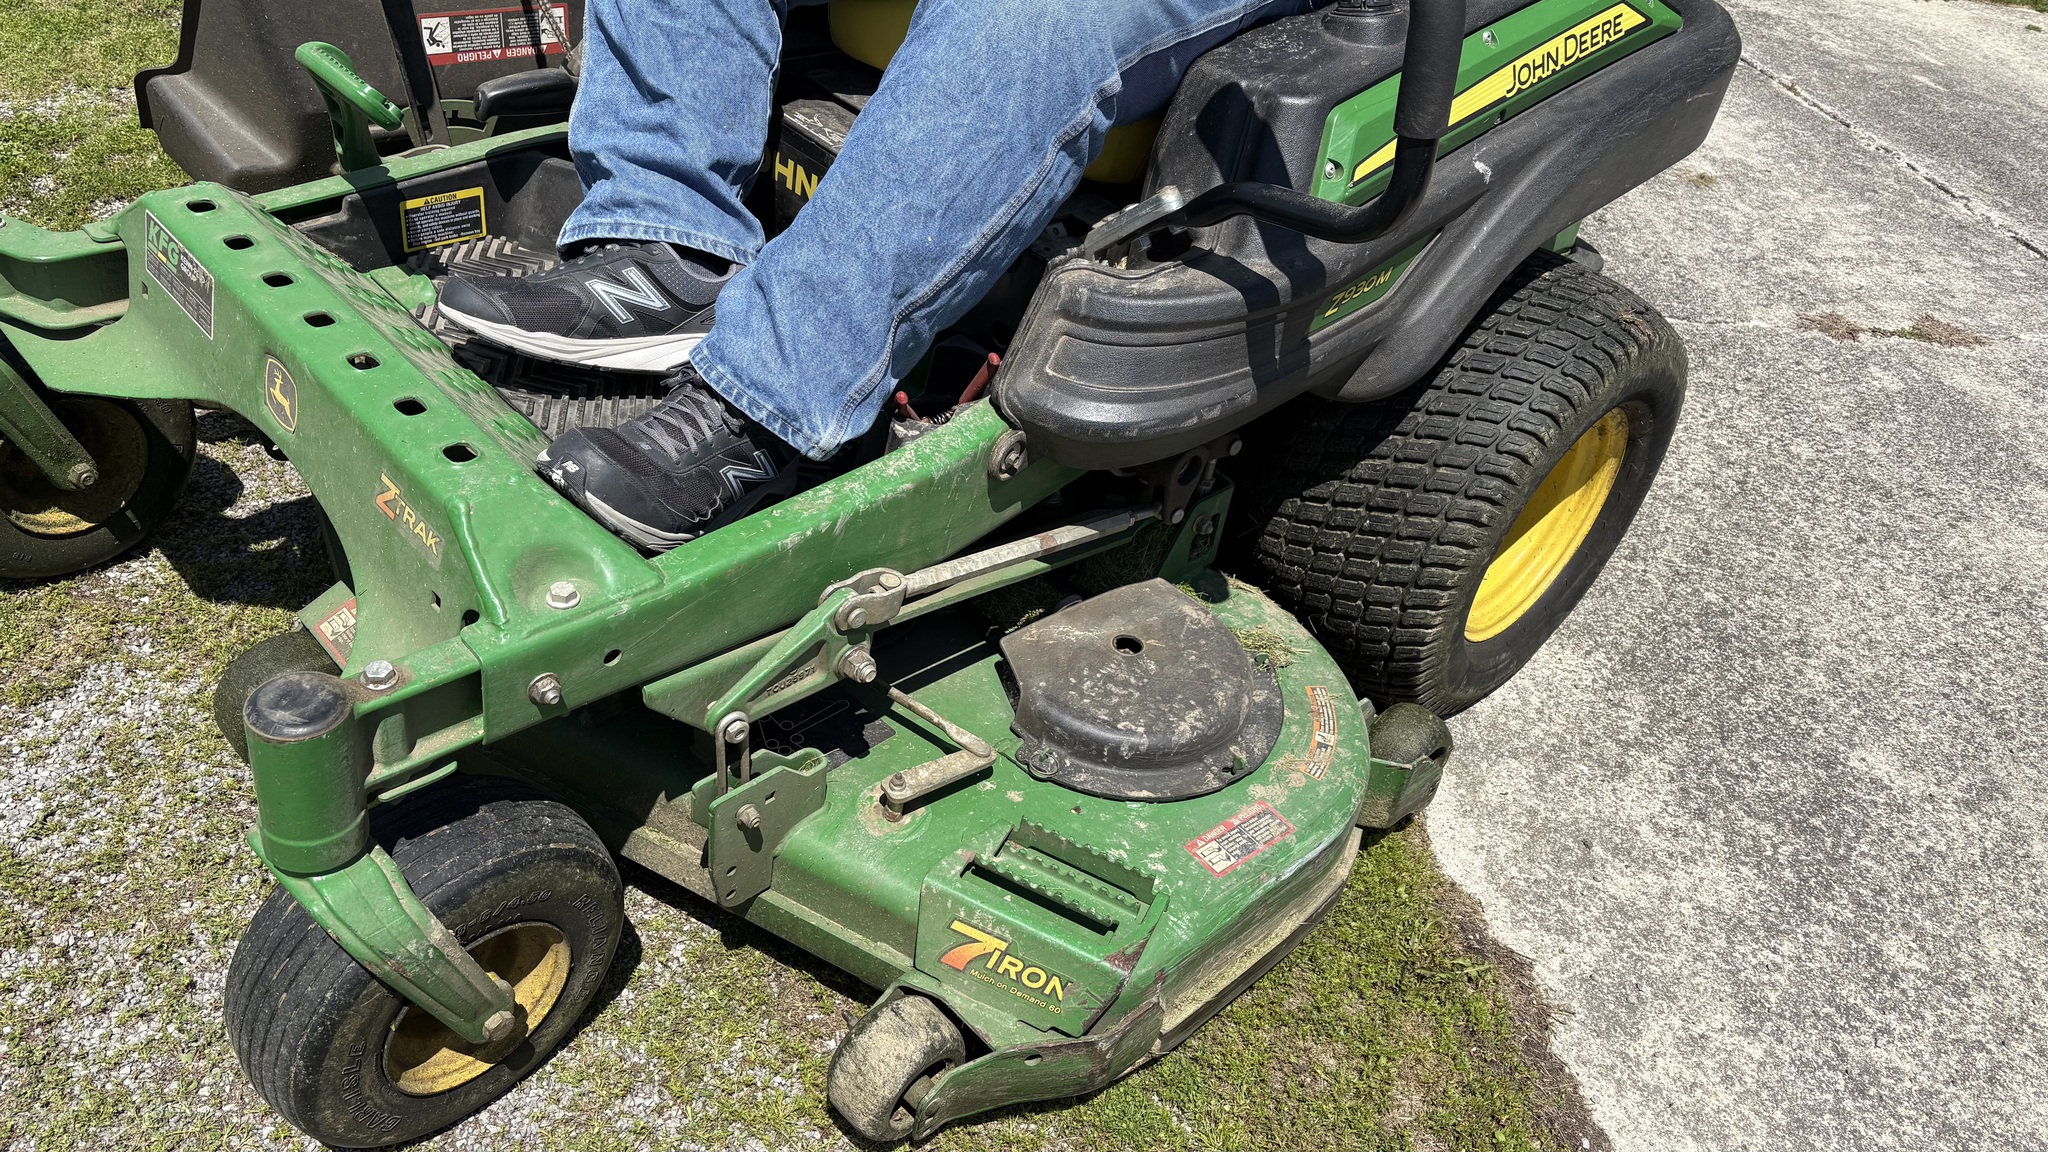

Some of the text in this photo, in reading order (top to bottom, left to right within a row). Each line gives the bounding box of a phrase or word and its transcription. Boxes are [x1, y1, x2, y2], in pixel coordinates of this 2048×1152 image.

[457, 46, 538, 62] DANGER PELIGRO
[1506, 12, 1623, 95] JOHN DEERE
[430, 193, 457, 203] CAUTION
[148, 220, 179, 266] KFG
[1324, 266, 1394, 318] Z930M
[1202, 825, 1227, 841] DANGER
[572, 893, 608, 1000] RELIANCE
[969, 968, 1061, 1014] Mulch on Demand 60
[341, 1040, 403, 1133] CARLISLE
